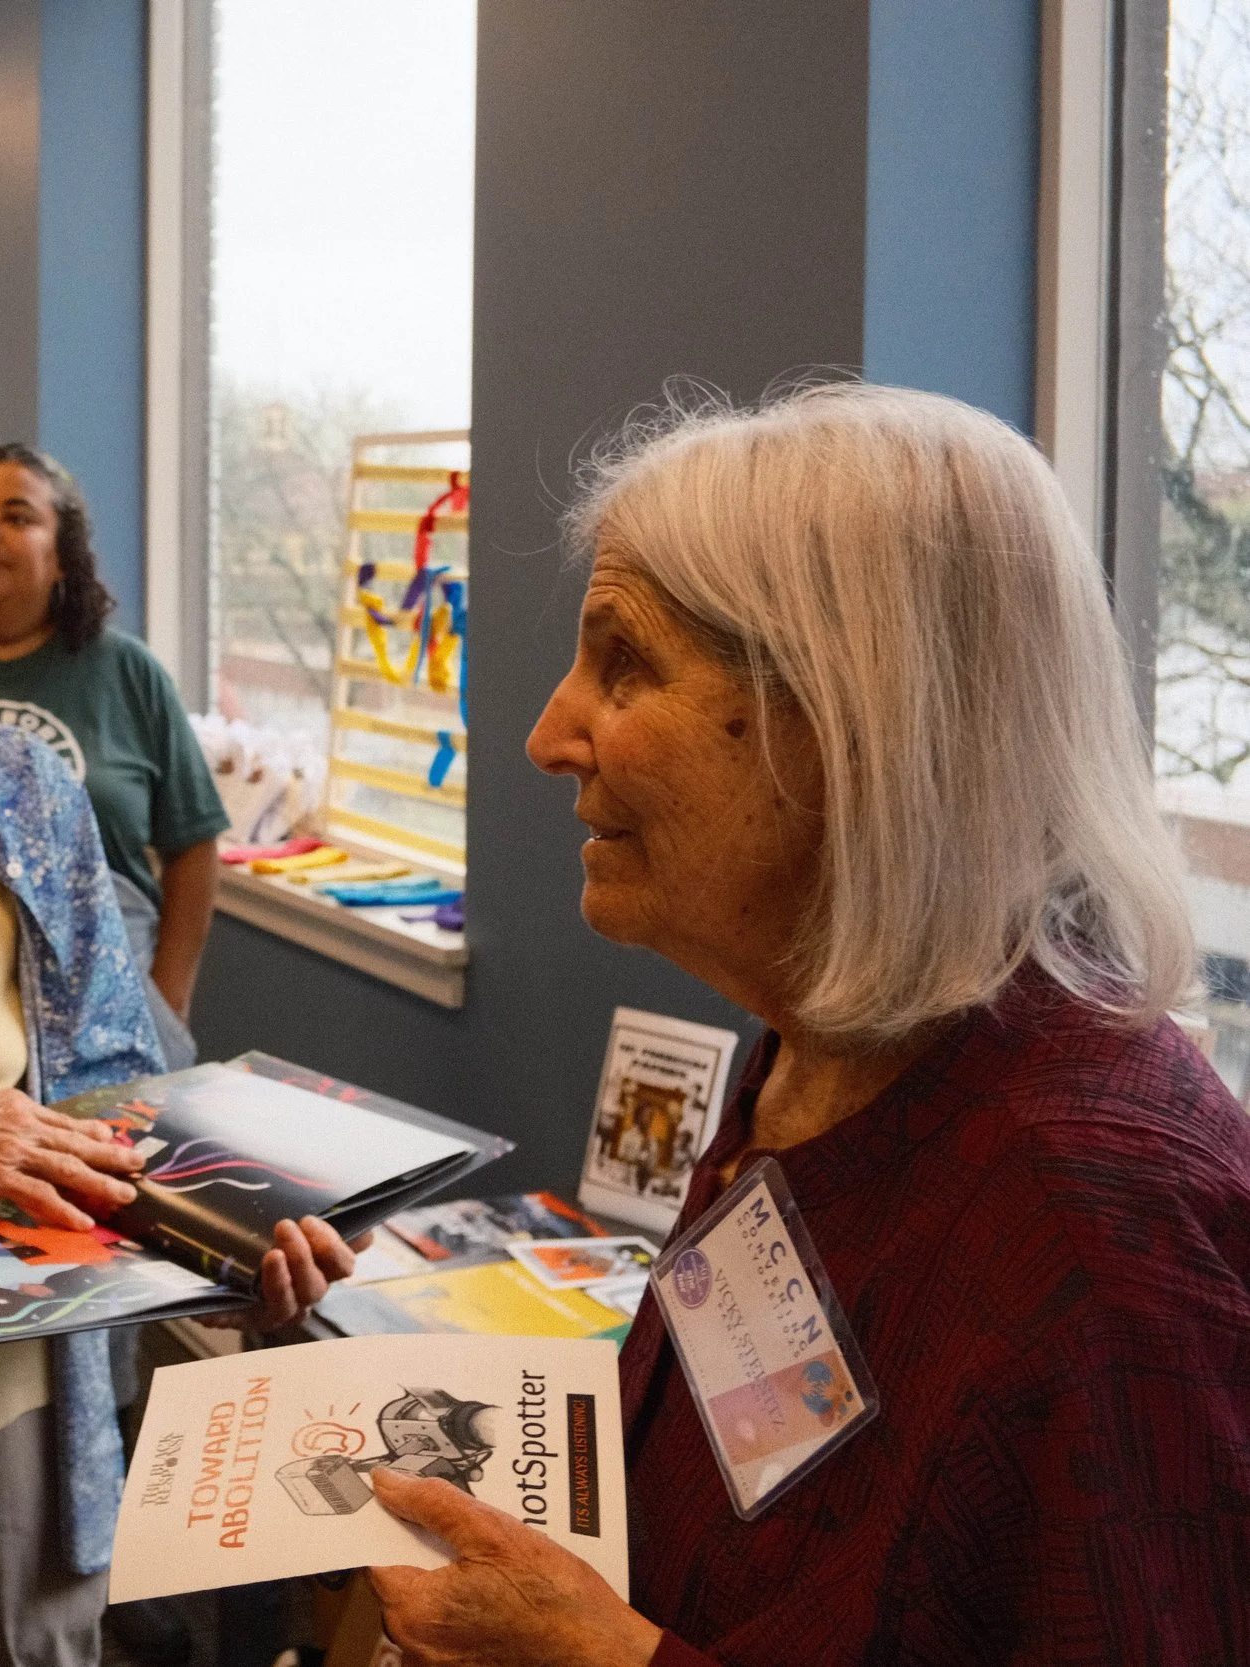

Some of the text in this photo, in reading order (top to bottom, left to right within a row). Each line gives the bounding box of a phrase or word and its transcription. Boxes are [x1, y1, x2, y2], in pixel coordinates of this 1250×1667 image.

[714, 1267, 746, 1331] VICKY
[750, 1197, 822, 1345] MCCN
[187, 1402, 236, 1528] TOWARD
[219, 1376, 271, 1548] ABOLITION
[572, 1399, 588, 1452] LISTENING!
[575, 1455, 590, 1505] ALWAYS
